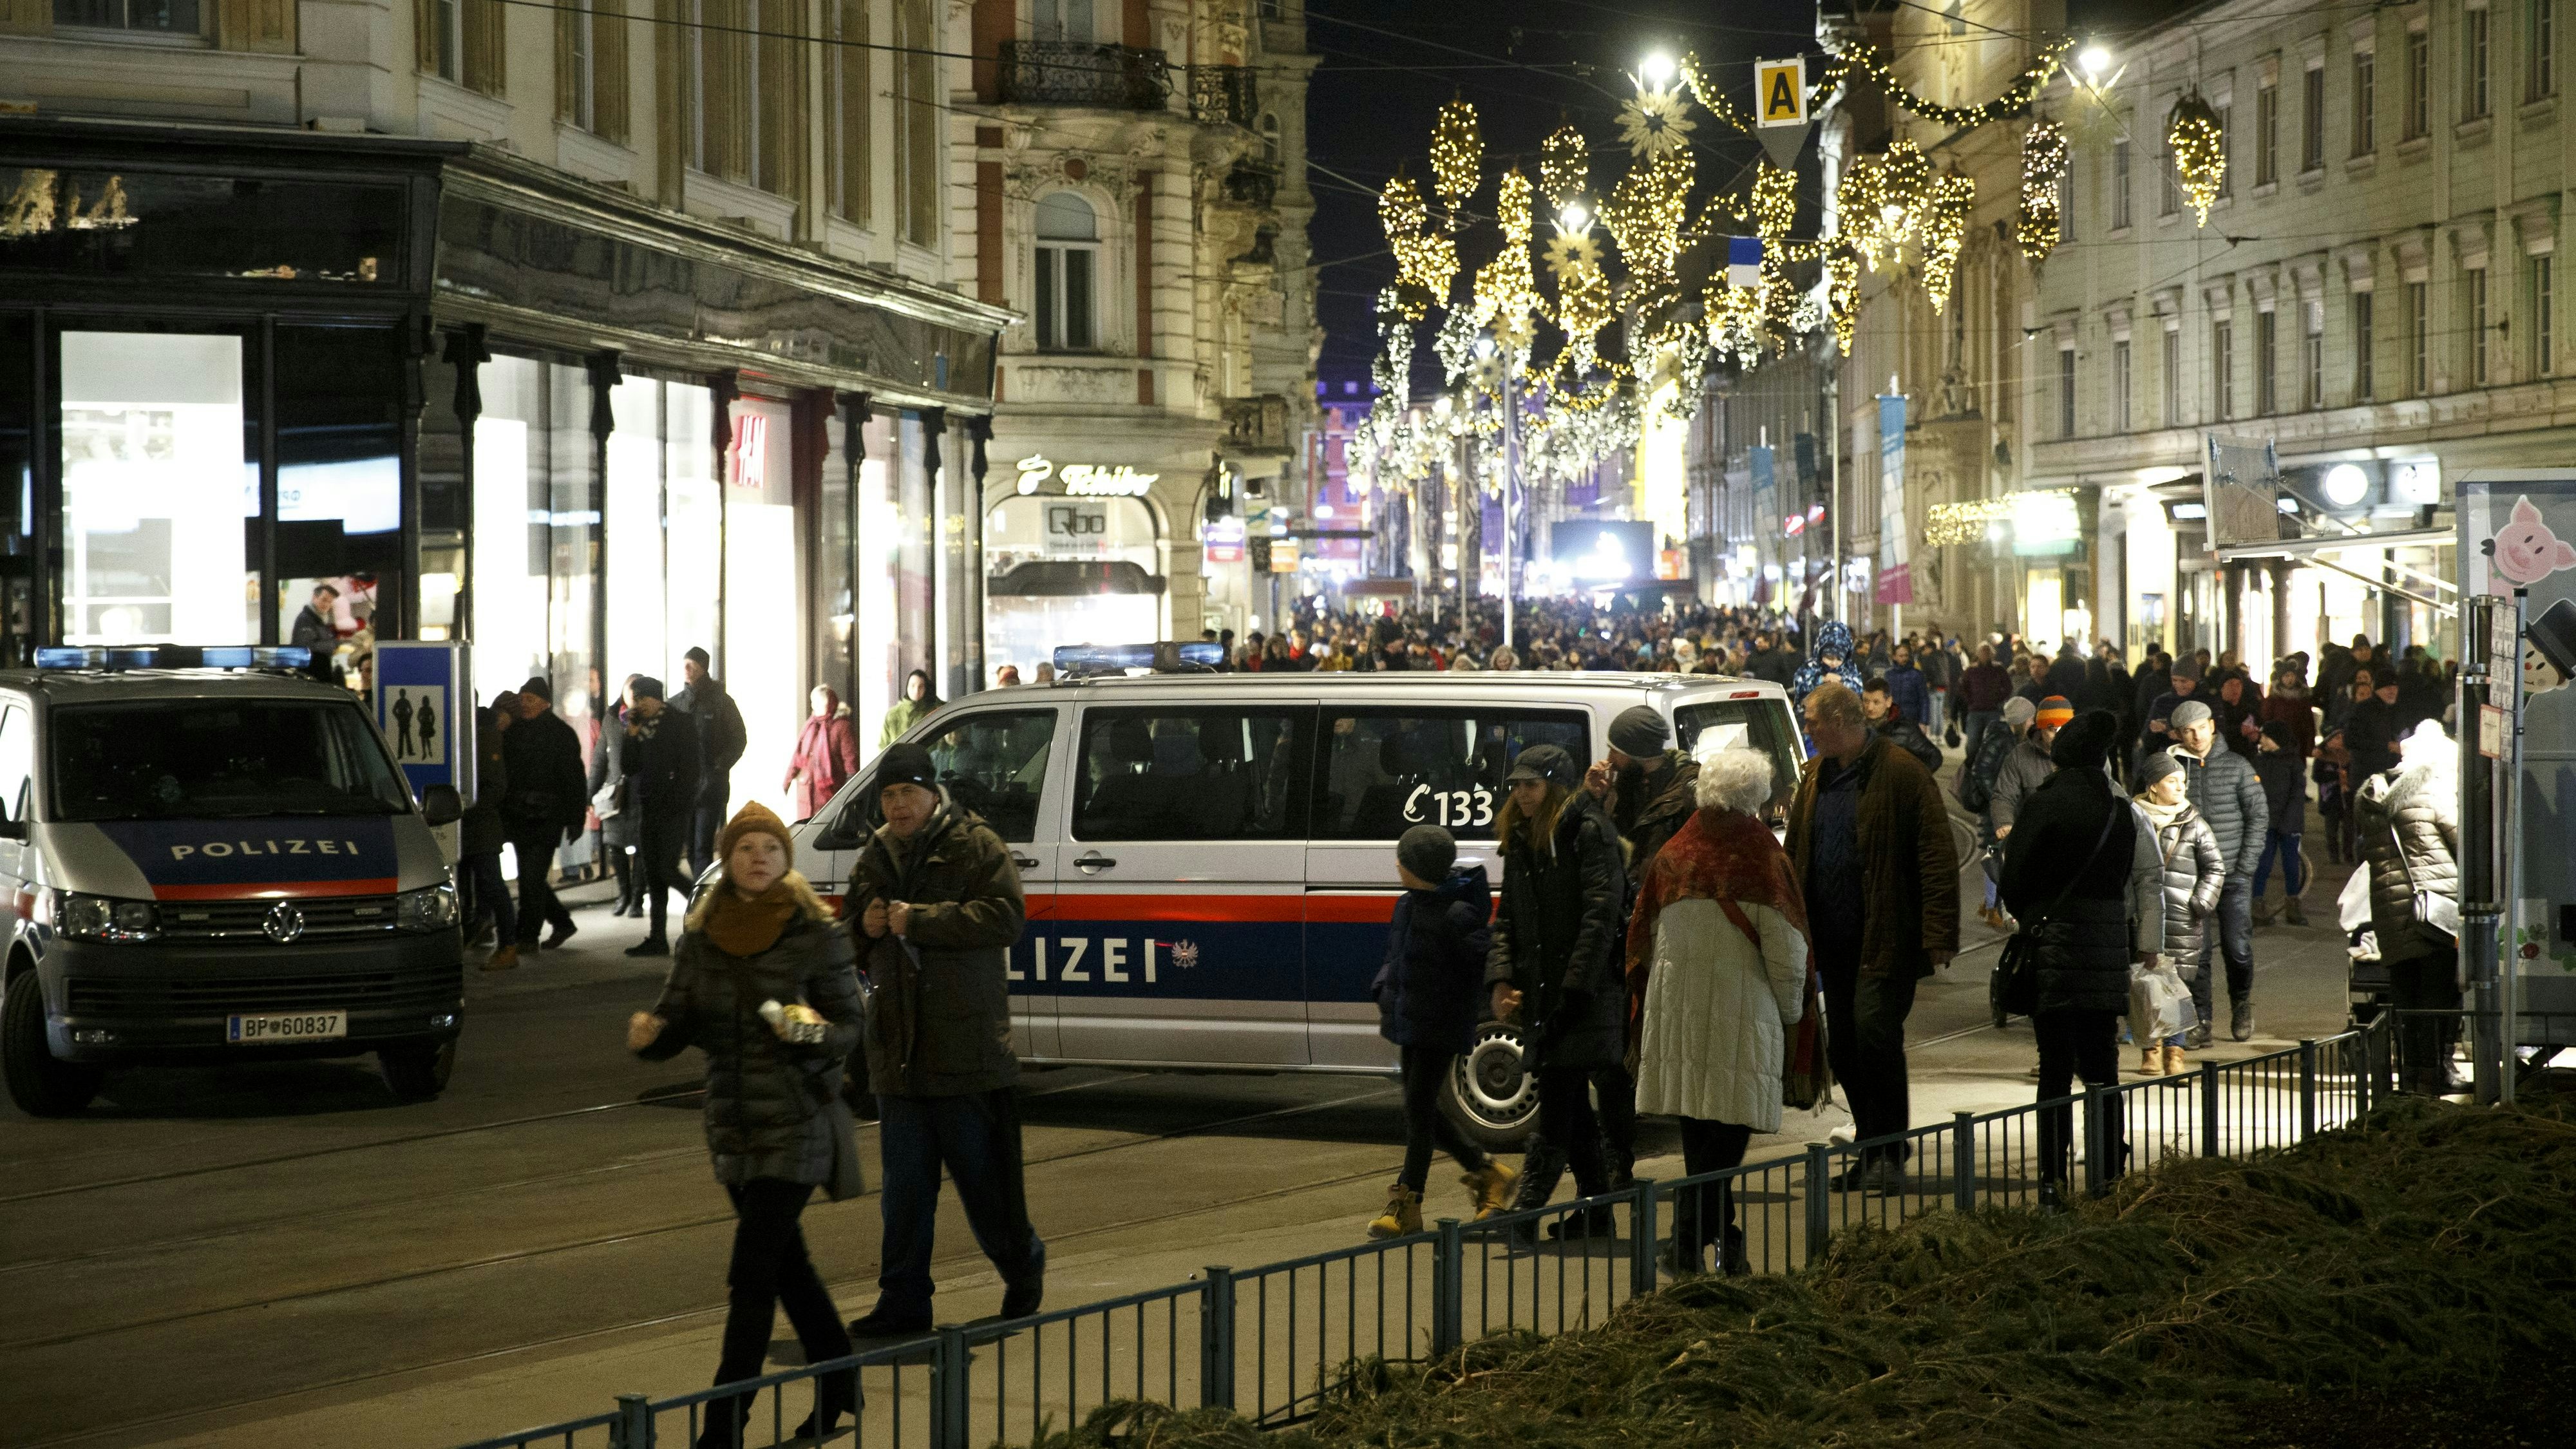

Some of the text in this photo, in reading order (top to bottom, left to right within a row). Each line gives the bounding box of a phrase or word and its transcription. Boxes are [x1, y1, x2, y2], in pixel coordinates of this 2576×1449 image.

[1768, 72, 1796, 115] A
[1059, 464, 1159, 496] Tchibo
[1049, 507, 1104, 536] Qbo
[1434, 791, 1493, 826] 133
[170, 840, 359, 860] POLIZEI
[246, 1016, 337, 1036] BP 60837
